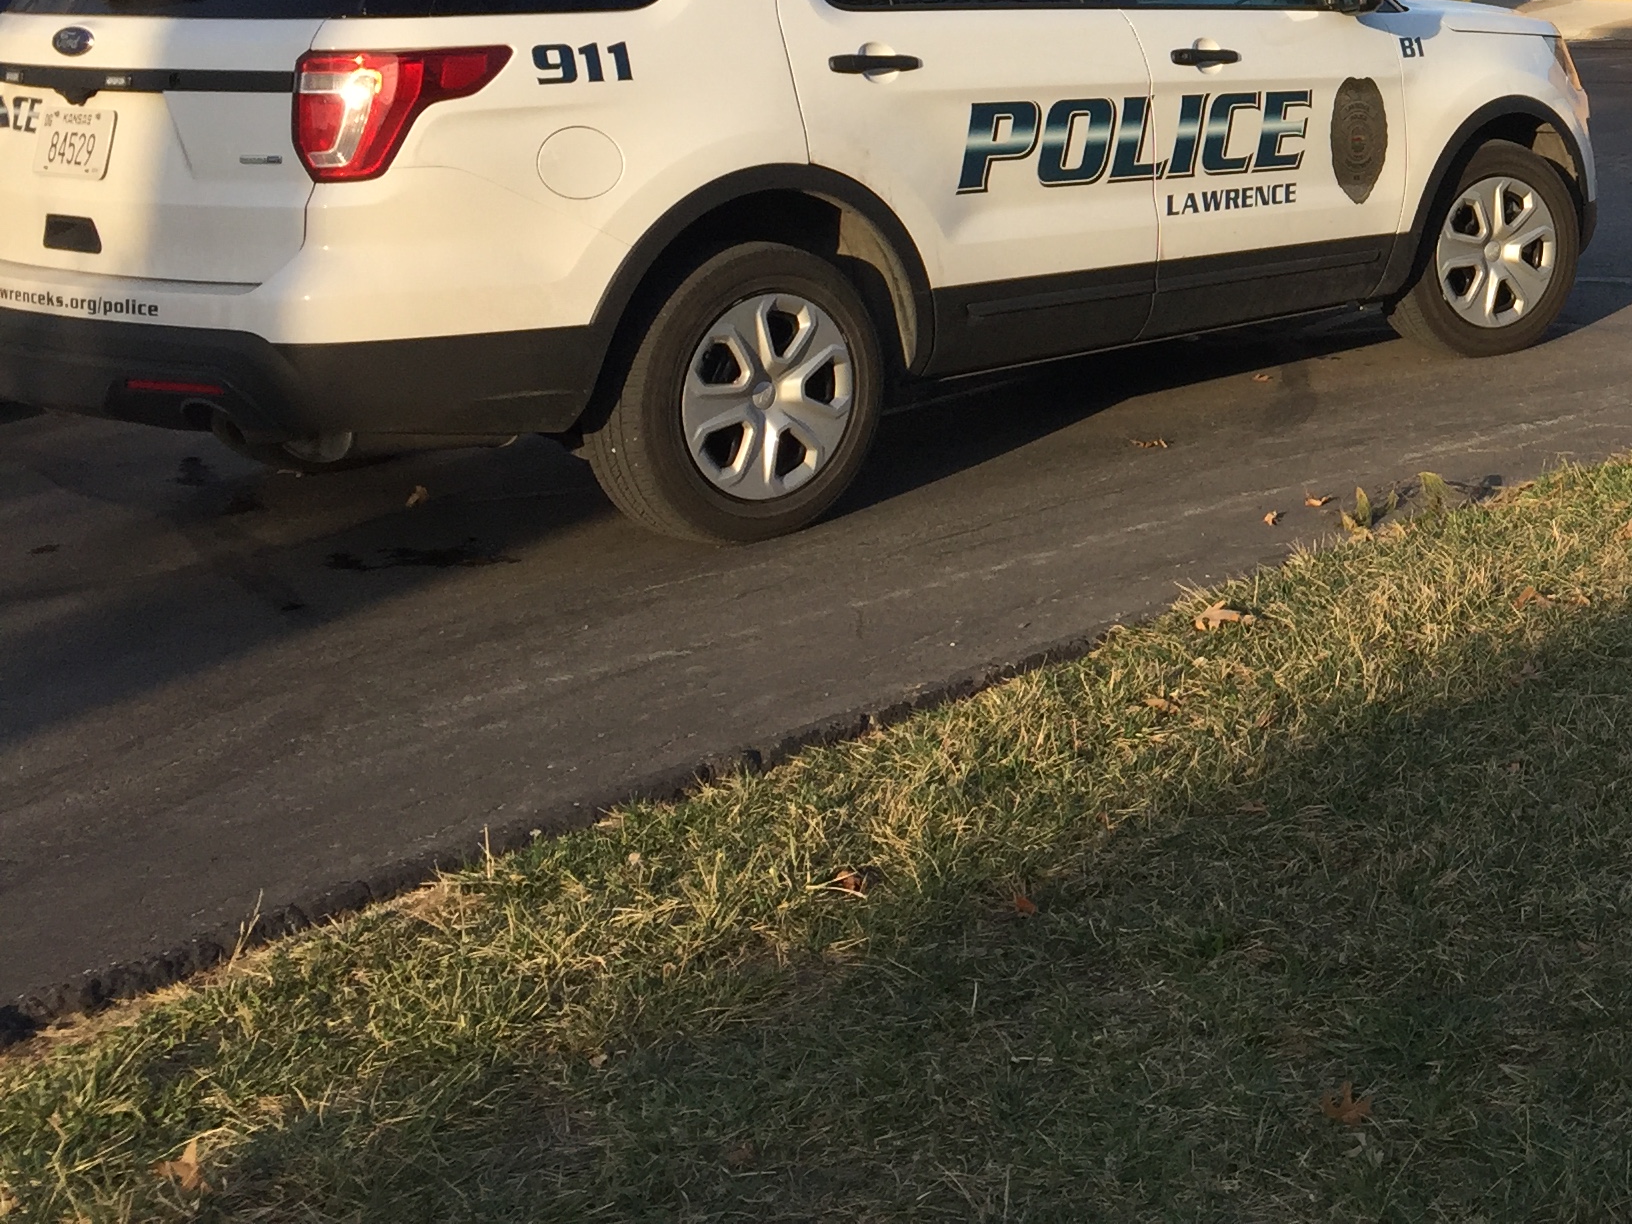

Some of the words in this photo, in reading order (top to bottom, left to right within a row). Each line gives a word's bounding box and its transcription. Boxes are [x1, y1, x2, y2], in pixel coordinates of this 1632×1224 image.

[531, 41, 634, 86] 911
[1399, 36, 1425, 58] B1
[62, 112, 93, 126] KANSAS
[47, 130, 96, 167] 84529
[956, 89, 1313, 196] POLICE
[1166, 182, 1297, 216] LAWRENCE
